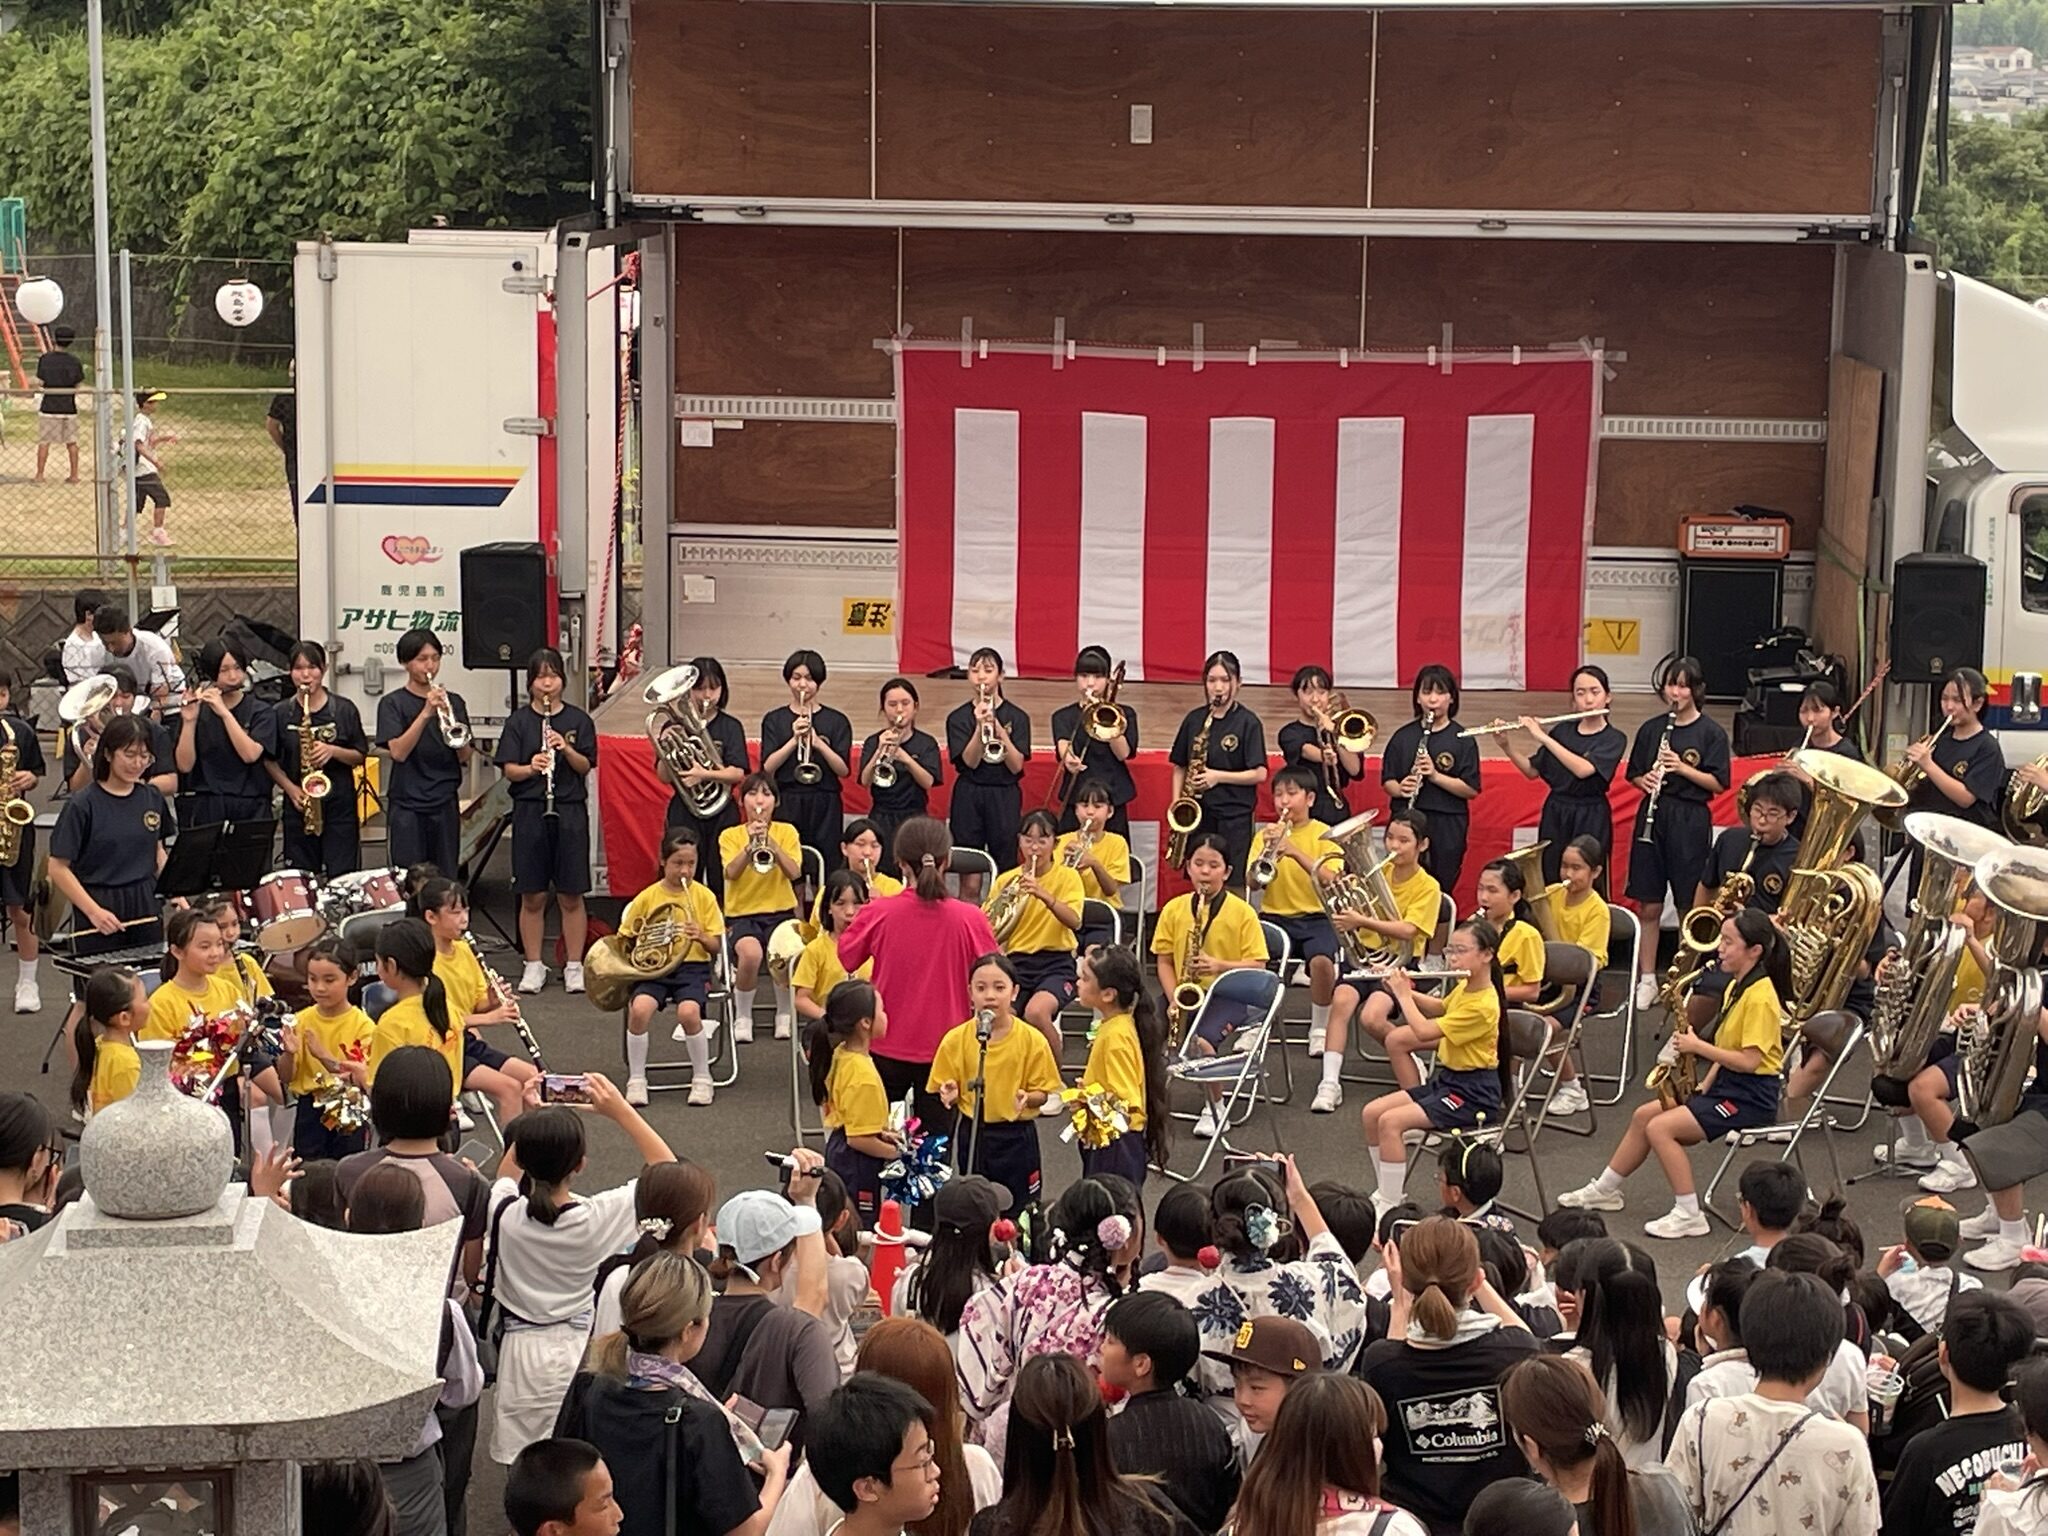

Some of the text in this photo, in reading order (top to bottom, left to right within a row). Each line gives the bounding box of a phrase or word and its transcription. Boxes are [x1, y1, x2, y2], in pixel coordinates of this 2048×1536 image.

[337, 607, 462, 632] アサヒ物流
[1431, 1429, 1498, 1448] Columbia
